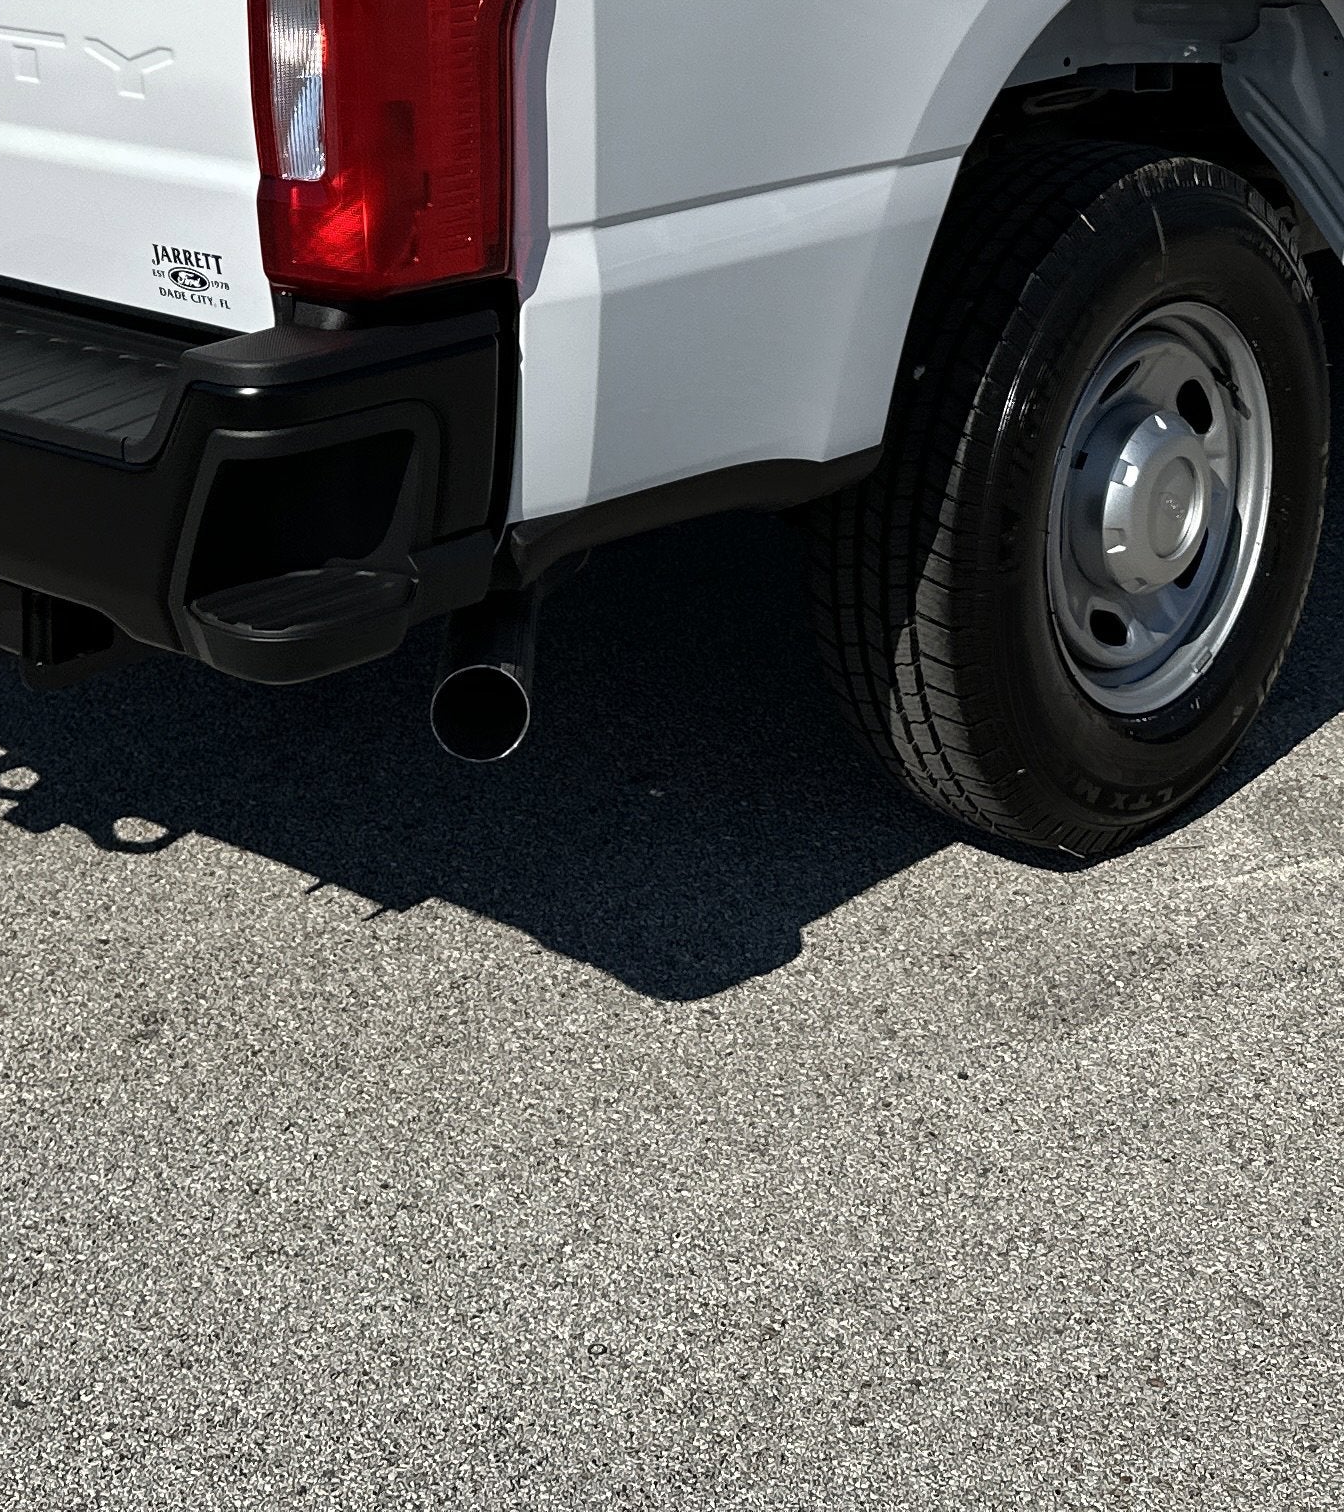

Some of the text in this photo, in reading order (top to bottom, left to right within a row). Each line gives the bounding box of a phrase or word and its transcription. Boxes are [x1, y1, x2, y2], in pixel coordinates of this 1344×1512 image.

[151, 243, 222, 275] JARRETT
[158, 286, 188, 301] DADE
[219, 298, 231, 310] FL
